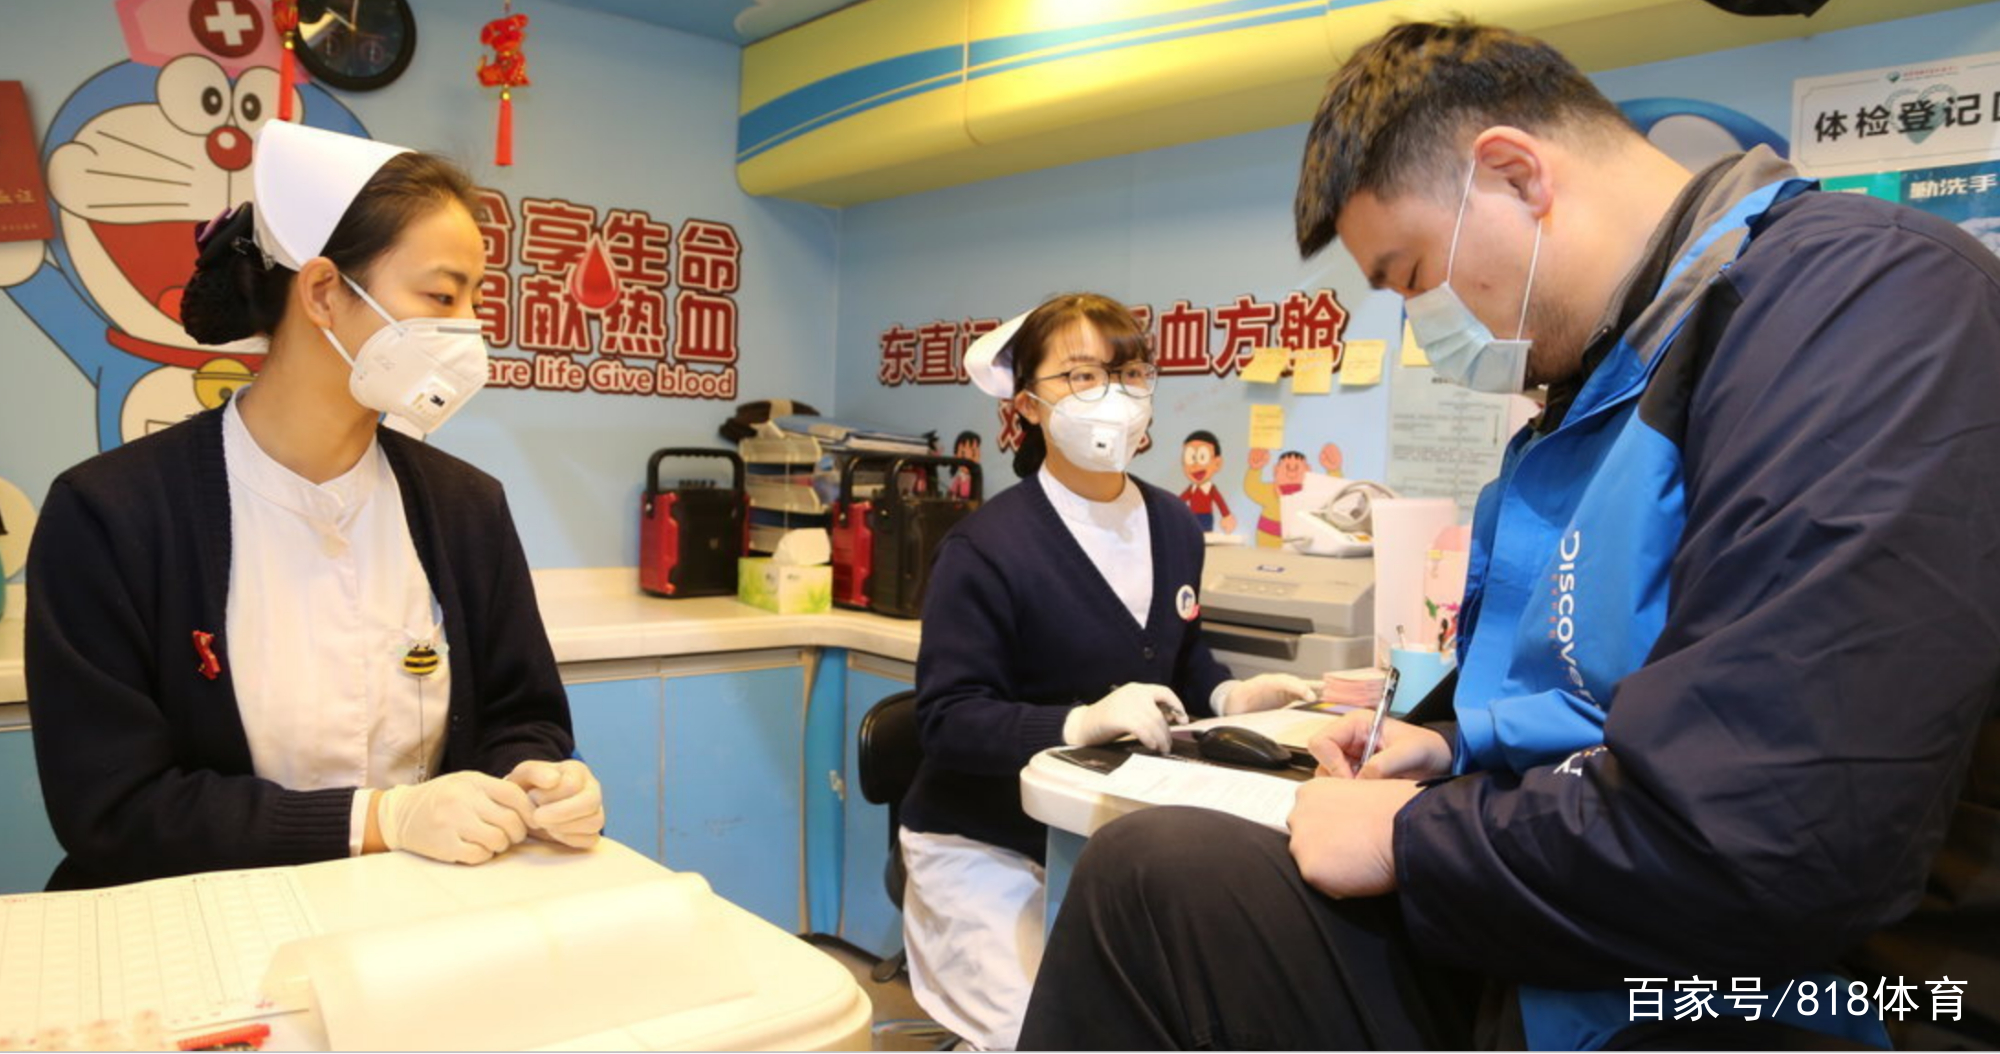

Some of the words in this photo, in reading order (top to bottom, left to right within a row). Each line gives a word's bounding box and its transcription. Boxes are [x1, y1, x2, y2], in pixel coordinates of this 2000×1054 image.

[1128, 288, 1351, 377] 血方舱
[486, 361, 530, 384] are
[535, 354, 585, 388] life
[589, 360, 651, 391] Give
[656, 362, 736, 397] blood
